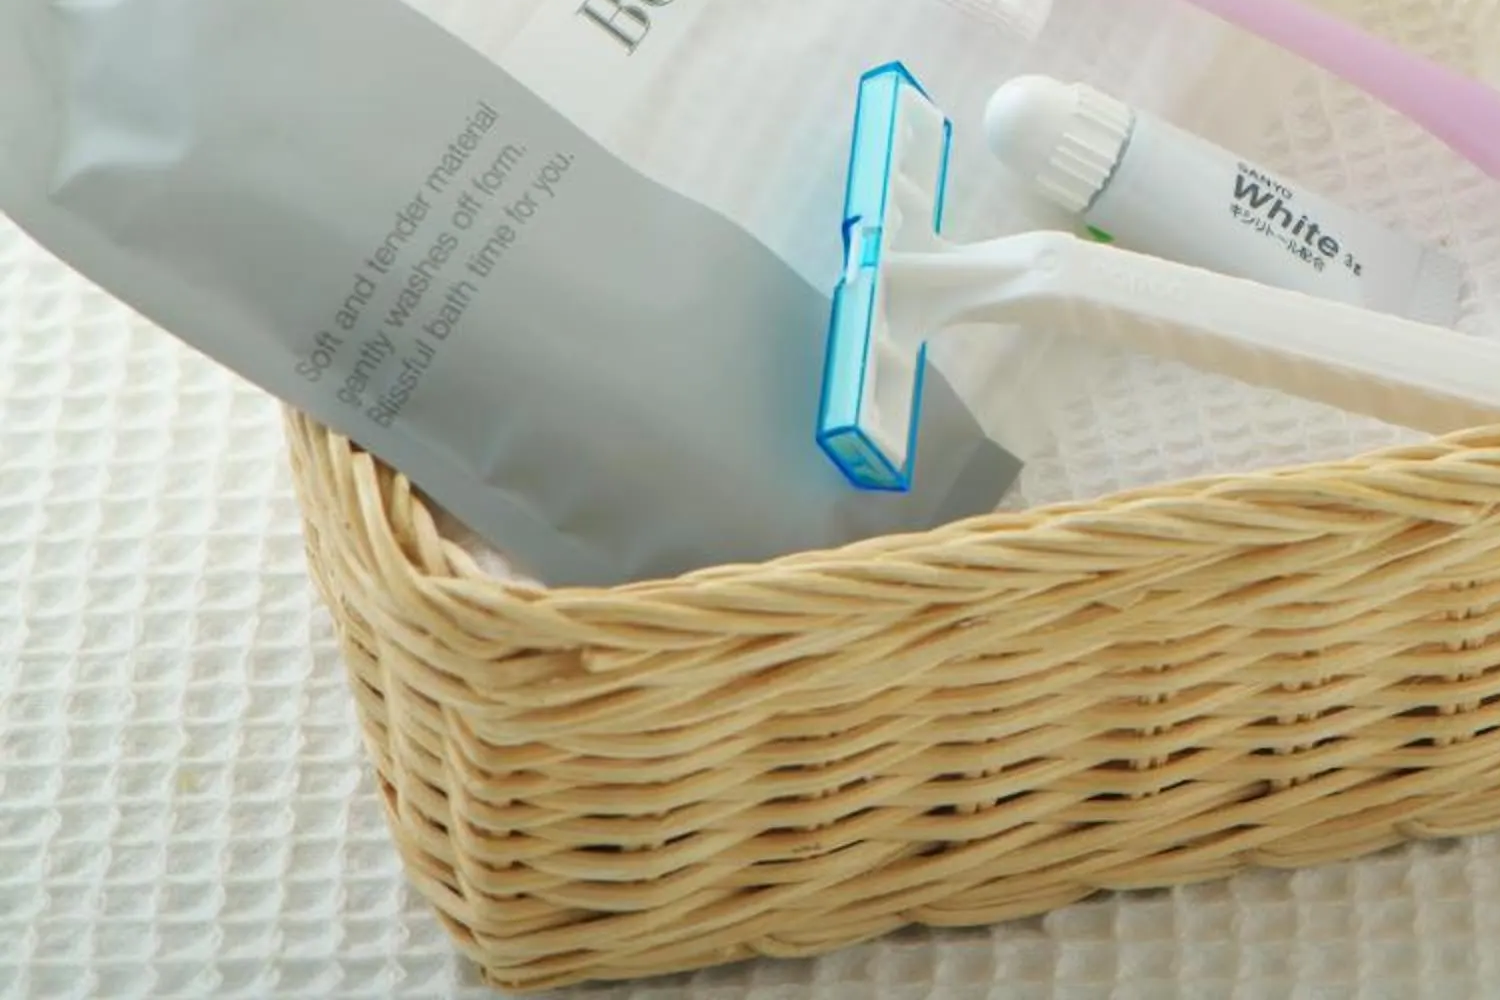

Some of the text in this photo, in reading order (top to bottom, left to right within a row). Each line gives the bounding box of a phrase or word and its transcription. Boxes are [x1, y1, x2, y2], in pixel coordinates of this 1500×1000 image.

[295, 101, 498, 383] Soft and tender material
[335, 330, 396, 410] gently
[384, 232, 459, 330] washes
[452, 190, 484, 232] off
[365, 151, 577, 430] Blissful bath time for you.
[1229, 203, 1327, 273] キシリトール配合
[1233, 173, 1340, 258] White
